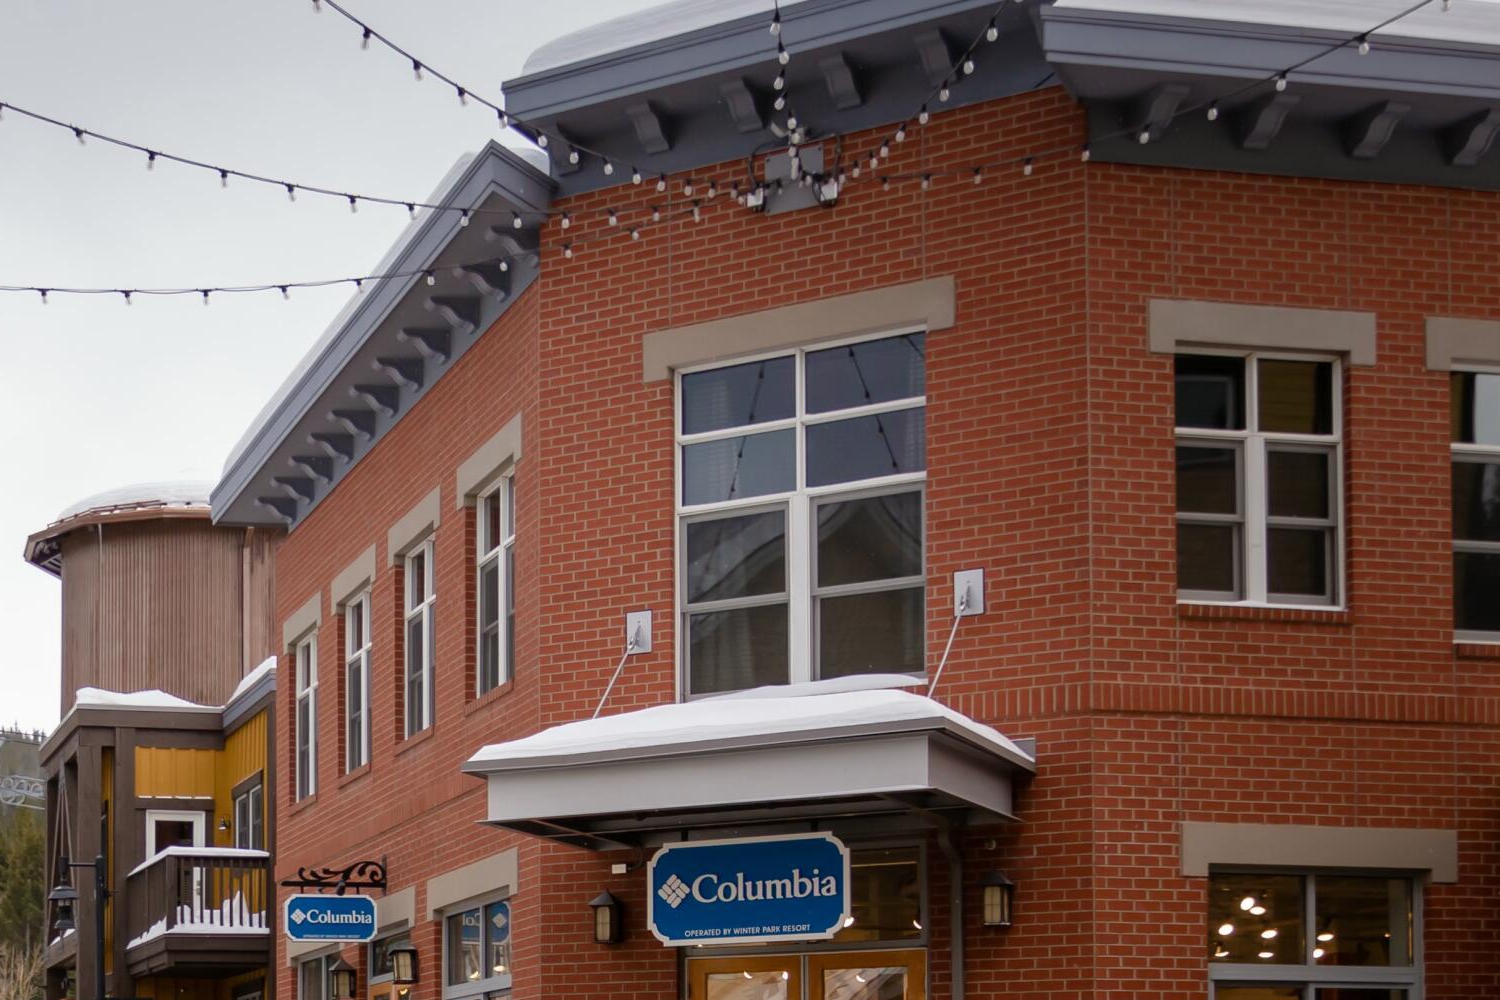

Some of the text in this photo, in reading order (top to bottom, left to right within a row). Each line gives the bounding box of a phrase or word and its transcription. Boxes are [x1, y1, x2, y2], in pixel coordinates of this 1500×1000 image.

[691, 868, 837, 904] Columbia
[306, 908, 372, 924] Columbia
[684, 924, 810, 938] OPERATED BY WINTER PARK RESORT
